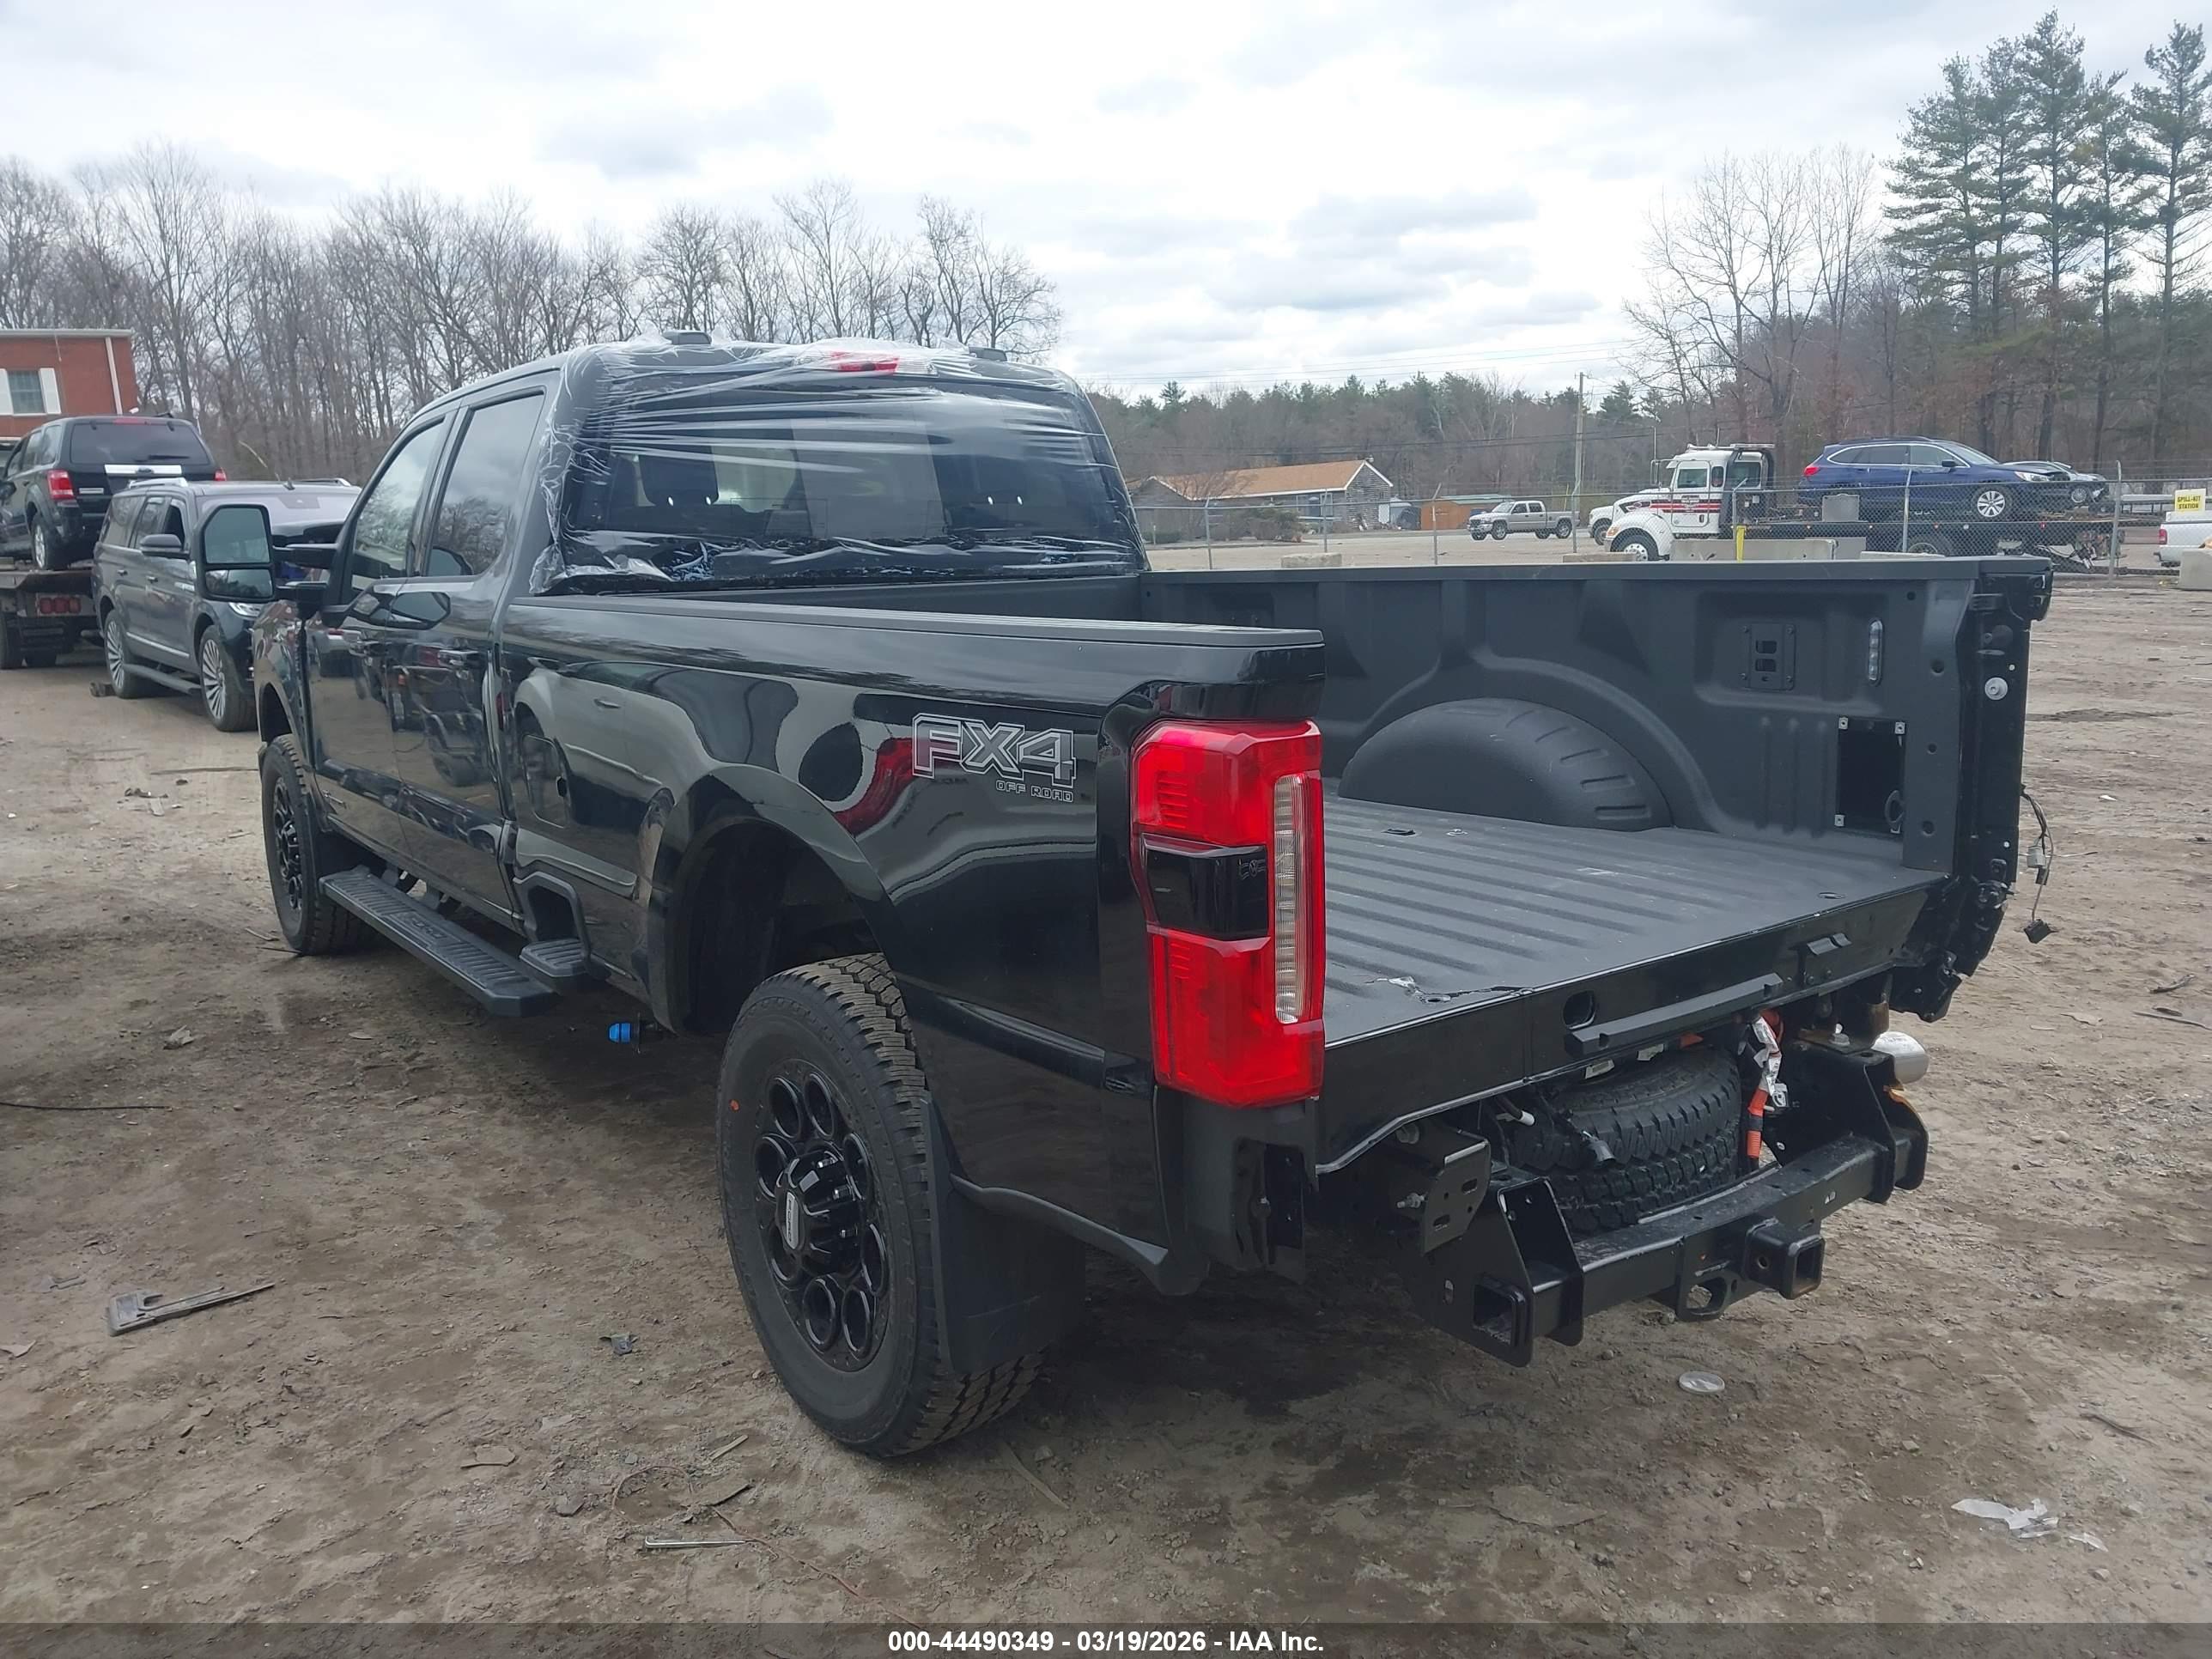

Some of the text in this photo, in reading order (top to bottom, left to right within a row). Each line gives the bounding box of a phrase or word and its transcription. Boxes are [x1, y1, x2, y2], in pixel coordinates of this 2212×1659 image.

[913, 713, 1076, 788] FX4
[996, 780, 1073, 802] OFF ROAD
